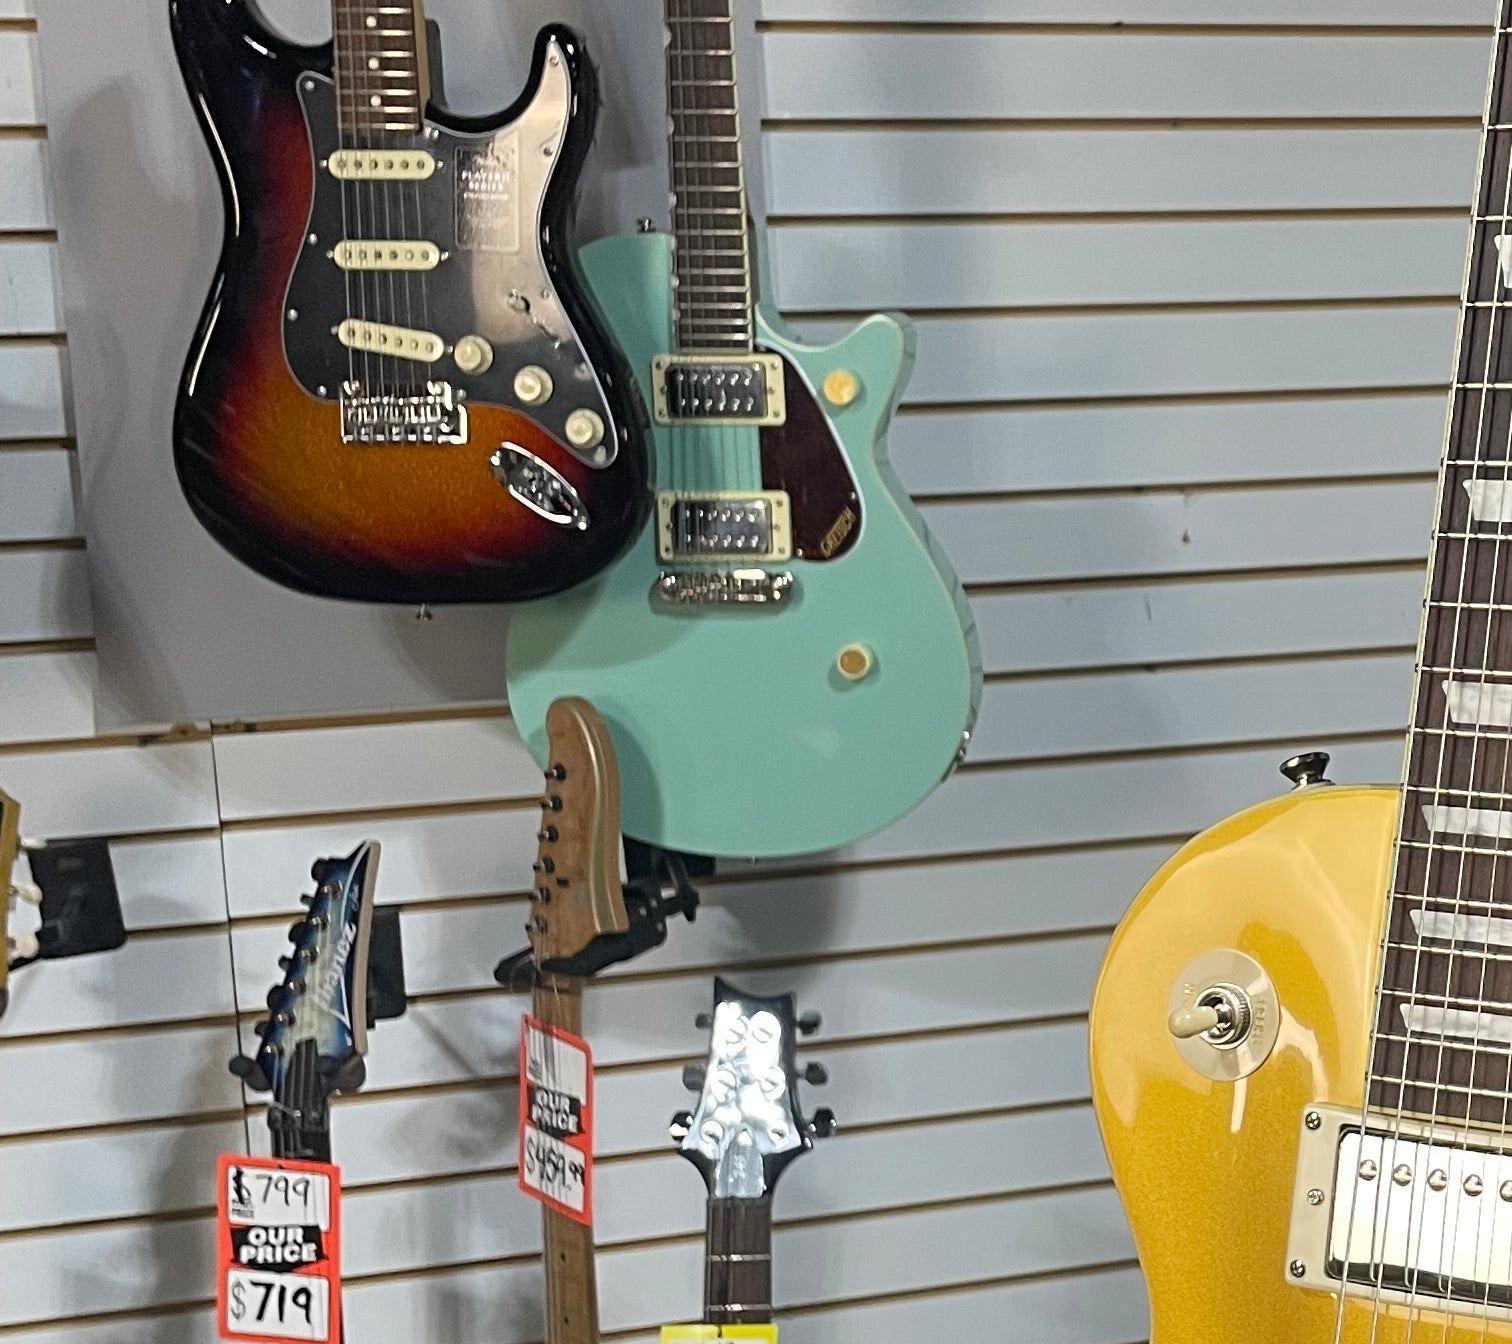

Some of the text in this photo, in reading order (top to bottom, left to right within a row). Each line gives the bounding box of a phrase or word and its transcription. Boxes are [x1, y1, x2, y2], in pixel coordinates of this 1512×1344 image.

[535, 1088, 571, 1114] OUR
[531, 1102, 579, 1134] PRICE
[247, 1227, 304, 1246] OUR
[239, 1243, 319, 1265] PRICE
[230, 1278, 312, 1324] $719
